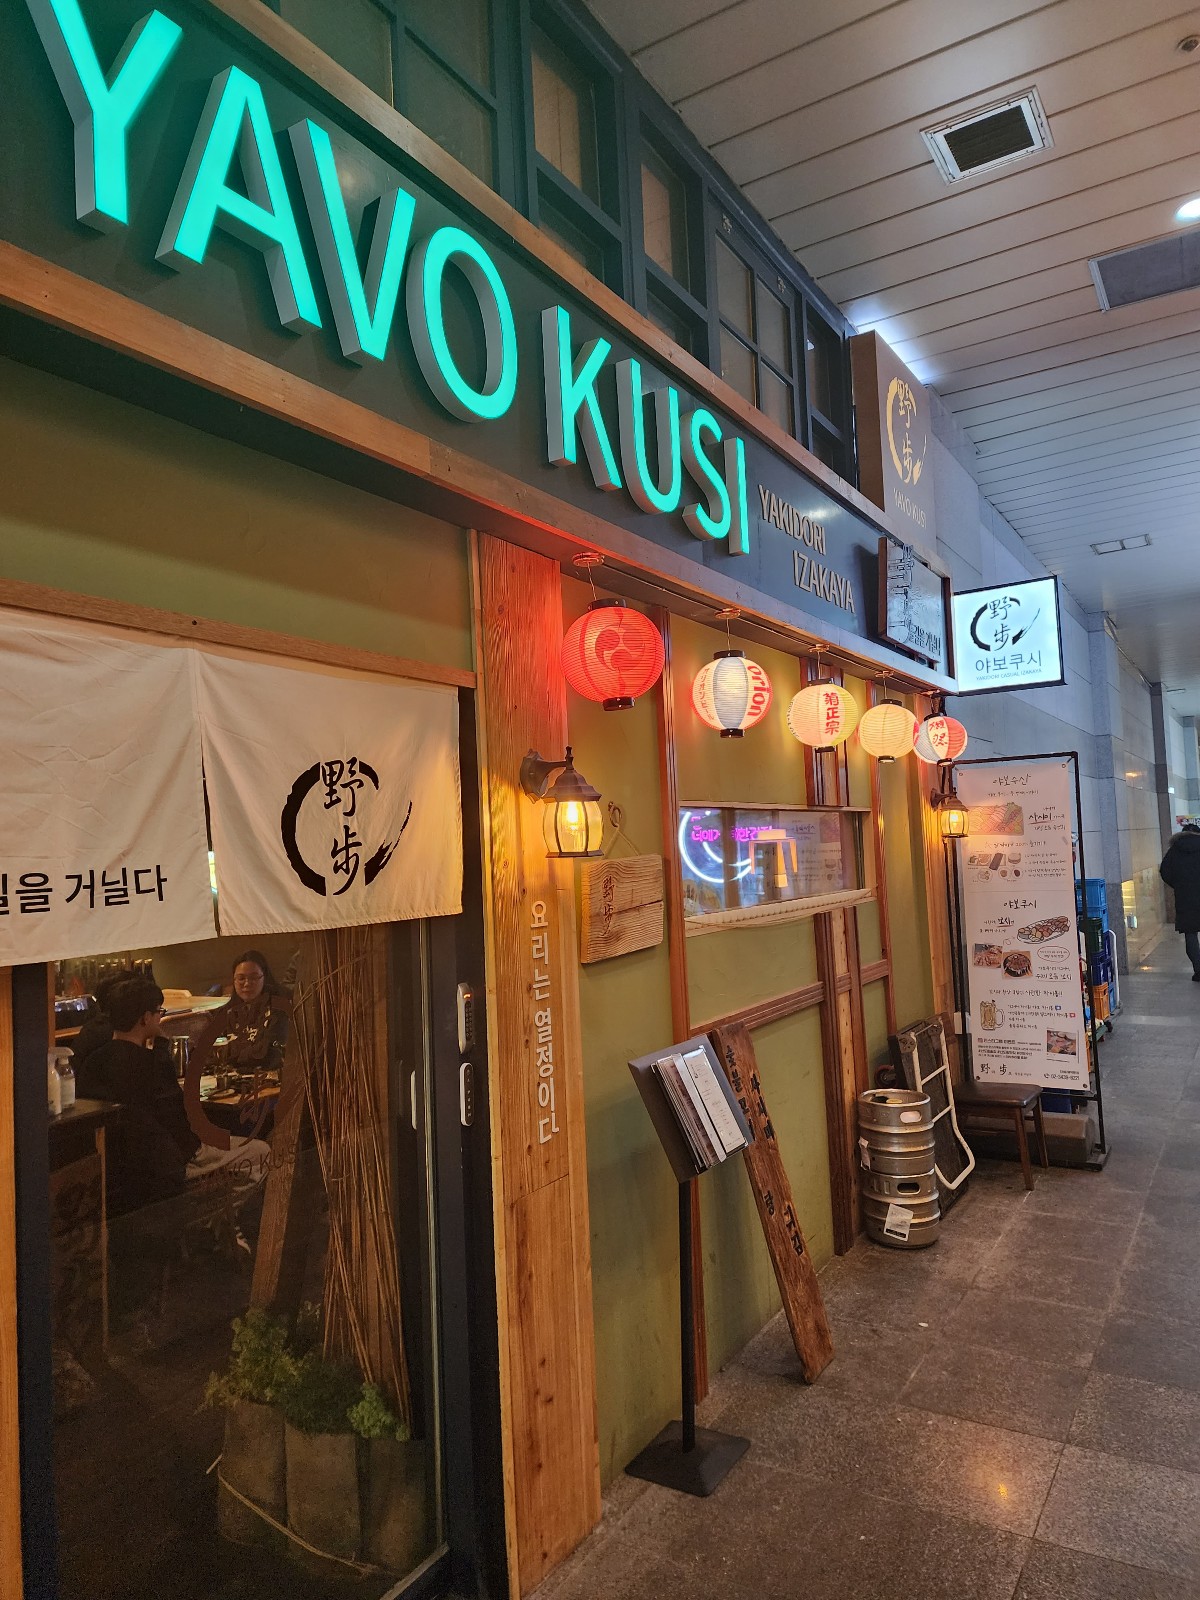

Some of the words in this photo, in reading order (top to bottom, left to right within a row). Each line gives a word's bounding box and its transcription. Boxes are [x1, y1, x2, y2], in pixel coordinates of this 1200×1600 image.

[24, 0, 518, 424] YAVO
[541, 304, 750, 557] KUSI
[758, 484, 827, 556] YAKIDORI
[792, 550, 857, 613] IZAKAYA
[975, 650, 1043, 674] 야보쿠시
[746, 665, 772, 718] orion
[822, 691, 841, 736] 菊正宗
[992, 773, 1032, 786] 야보수산
[64, 863, 168, 909] 거닐다
[1003, 899, 1037, 909] 야보쿠시
[530, 899, 551, 1002] 요리는
[534, 1006, 560, 1145] 열정이다
